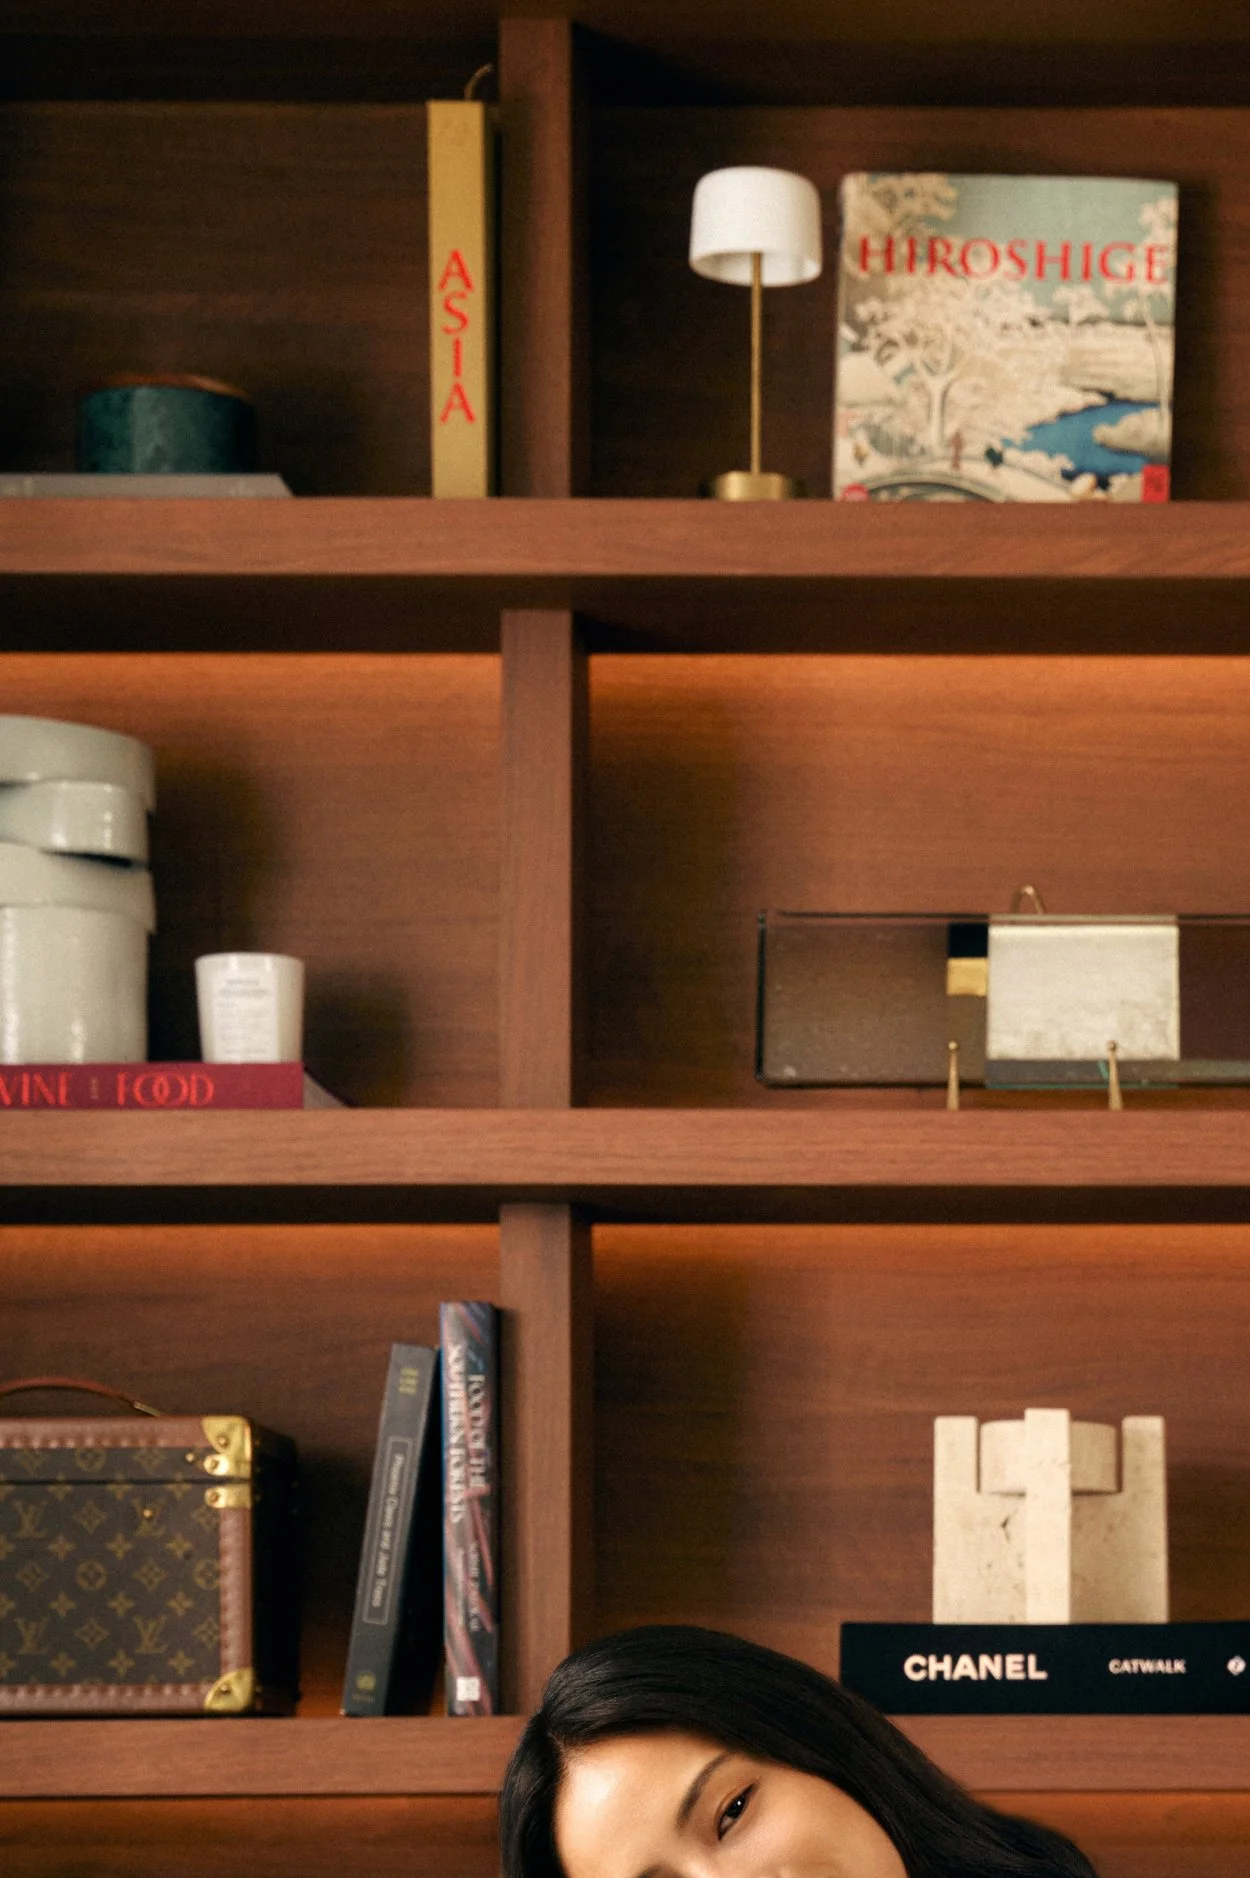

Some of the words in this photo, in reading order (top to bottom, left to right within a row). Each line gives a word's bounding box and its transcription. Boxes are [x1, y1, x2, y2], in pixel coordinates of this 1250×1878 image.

[857, 233, 1170, 286] HIROSHIGE
[437, 249, 476, 425] ASIA
[116, 1071, 215, 1108] FOOD
[903, 1653, 1049, 1682] CHANEL
[1108, 1657, 1187, 1675] CATWALK
